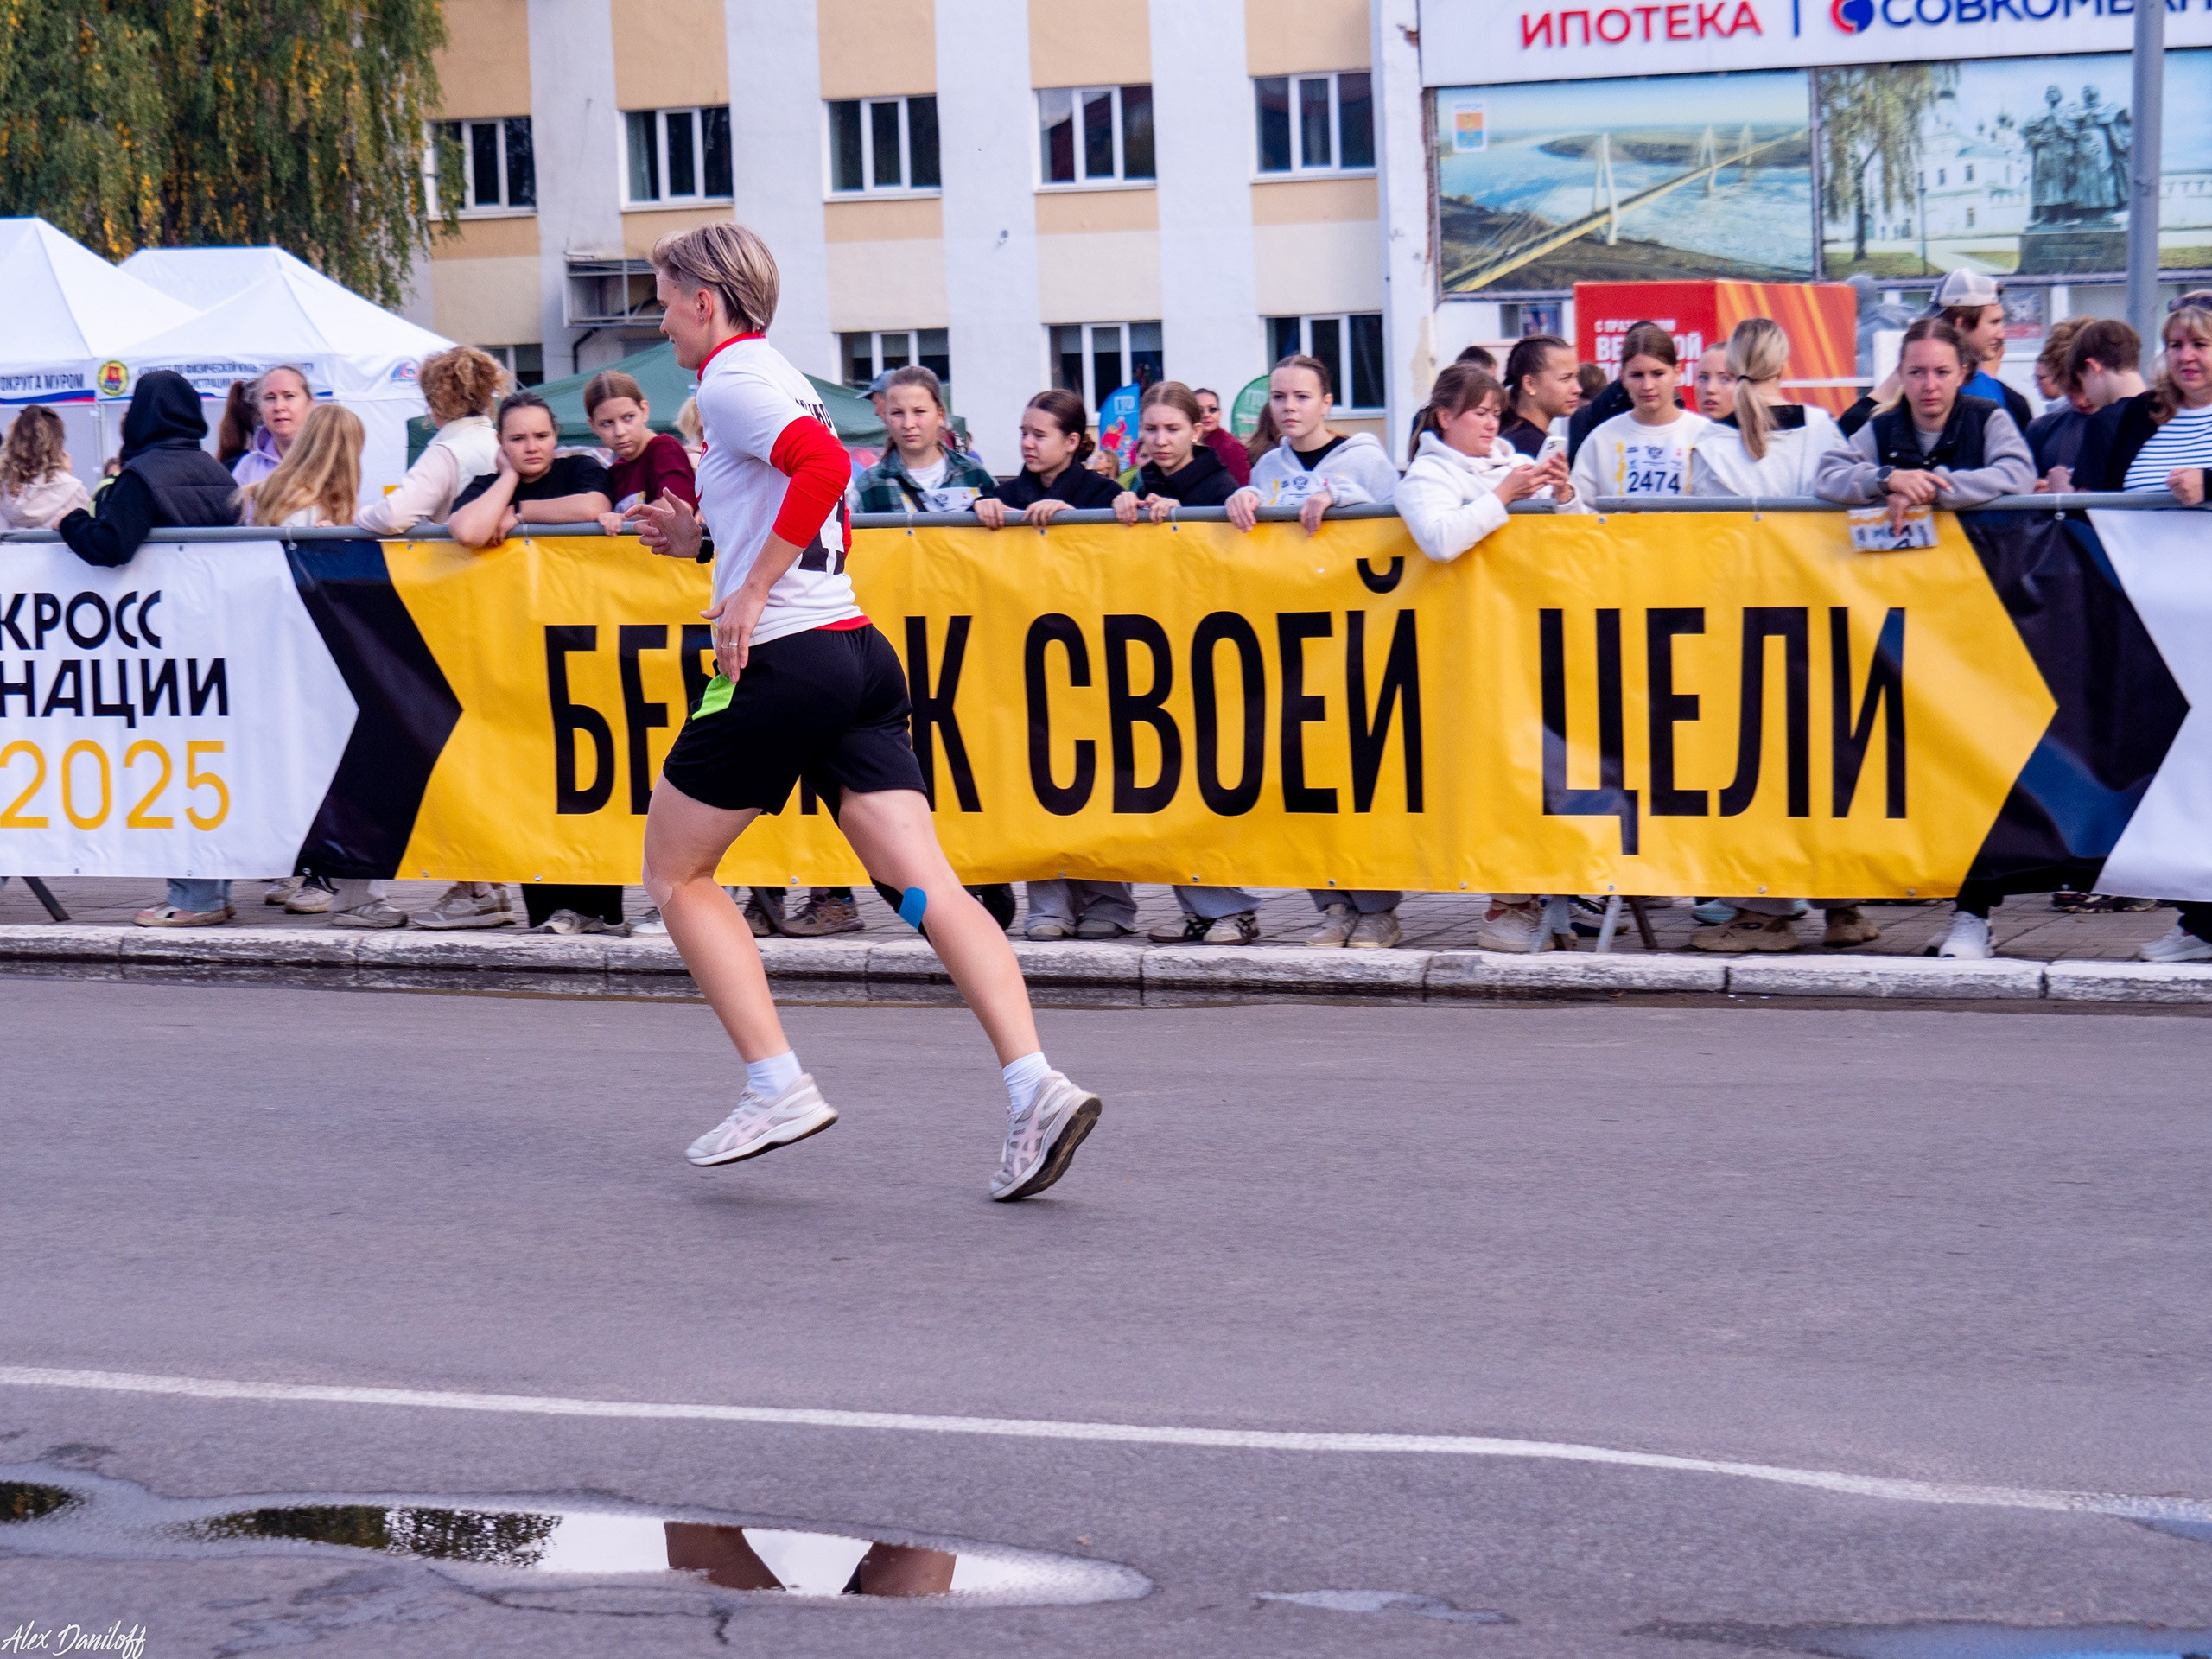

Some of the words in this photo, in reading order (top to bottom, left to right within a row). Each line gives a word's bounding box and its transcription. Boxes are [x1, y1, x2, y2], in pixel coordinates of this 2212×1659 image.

[1521, 2, 1763, 48] ИПОТЕКА
[1881, 0, 2212, 27] СОВКО
[1628, 470, 1681, 494] 2474
[0, 590, 162, 650] КРОСС
[0, 658, 229, 729] НАЦИИ
[905, 614, 983, 813] К
[1024, 556, 1424, 817] СВОЕЙ
[1539, 606, 1907, 855] ЦЕЛИ
[0, 739, 231, 832] 2025
